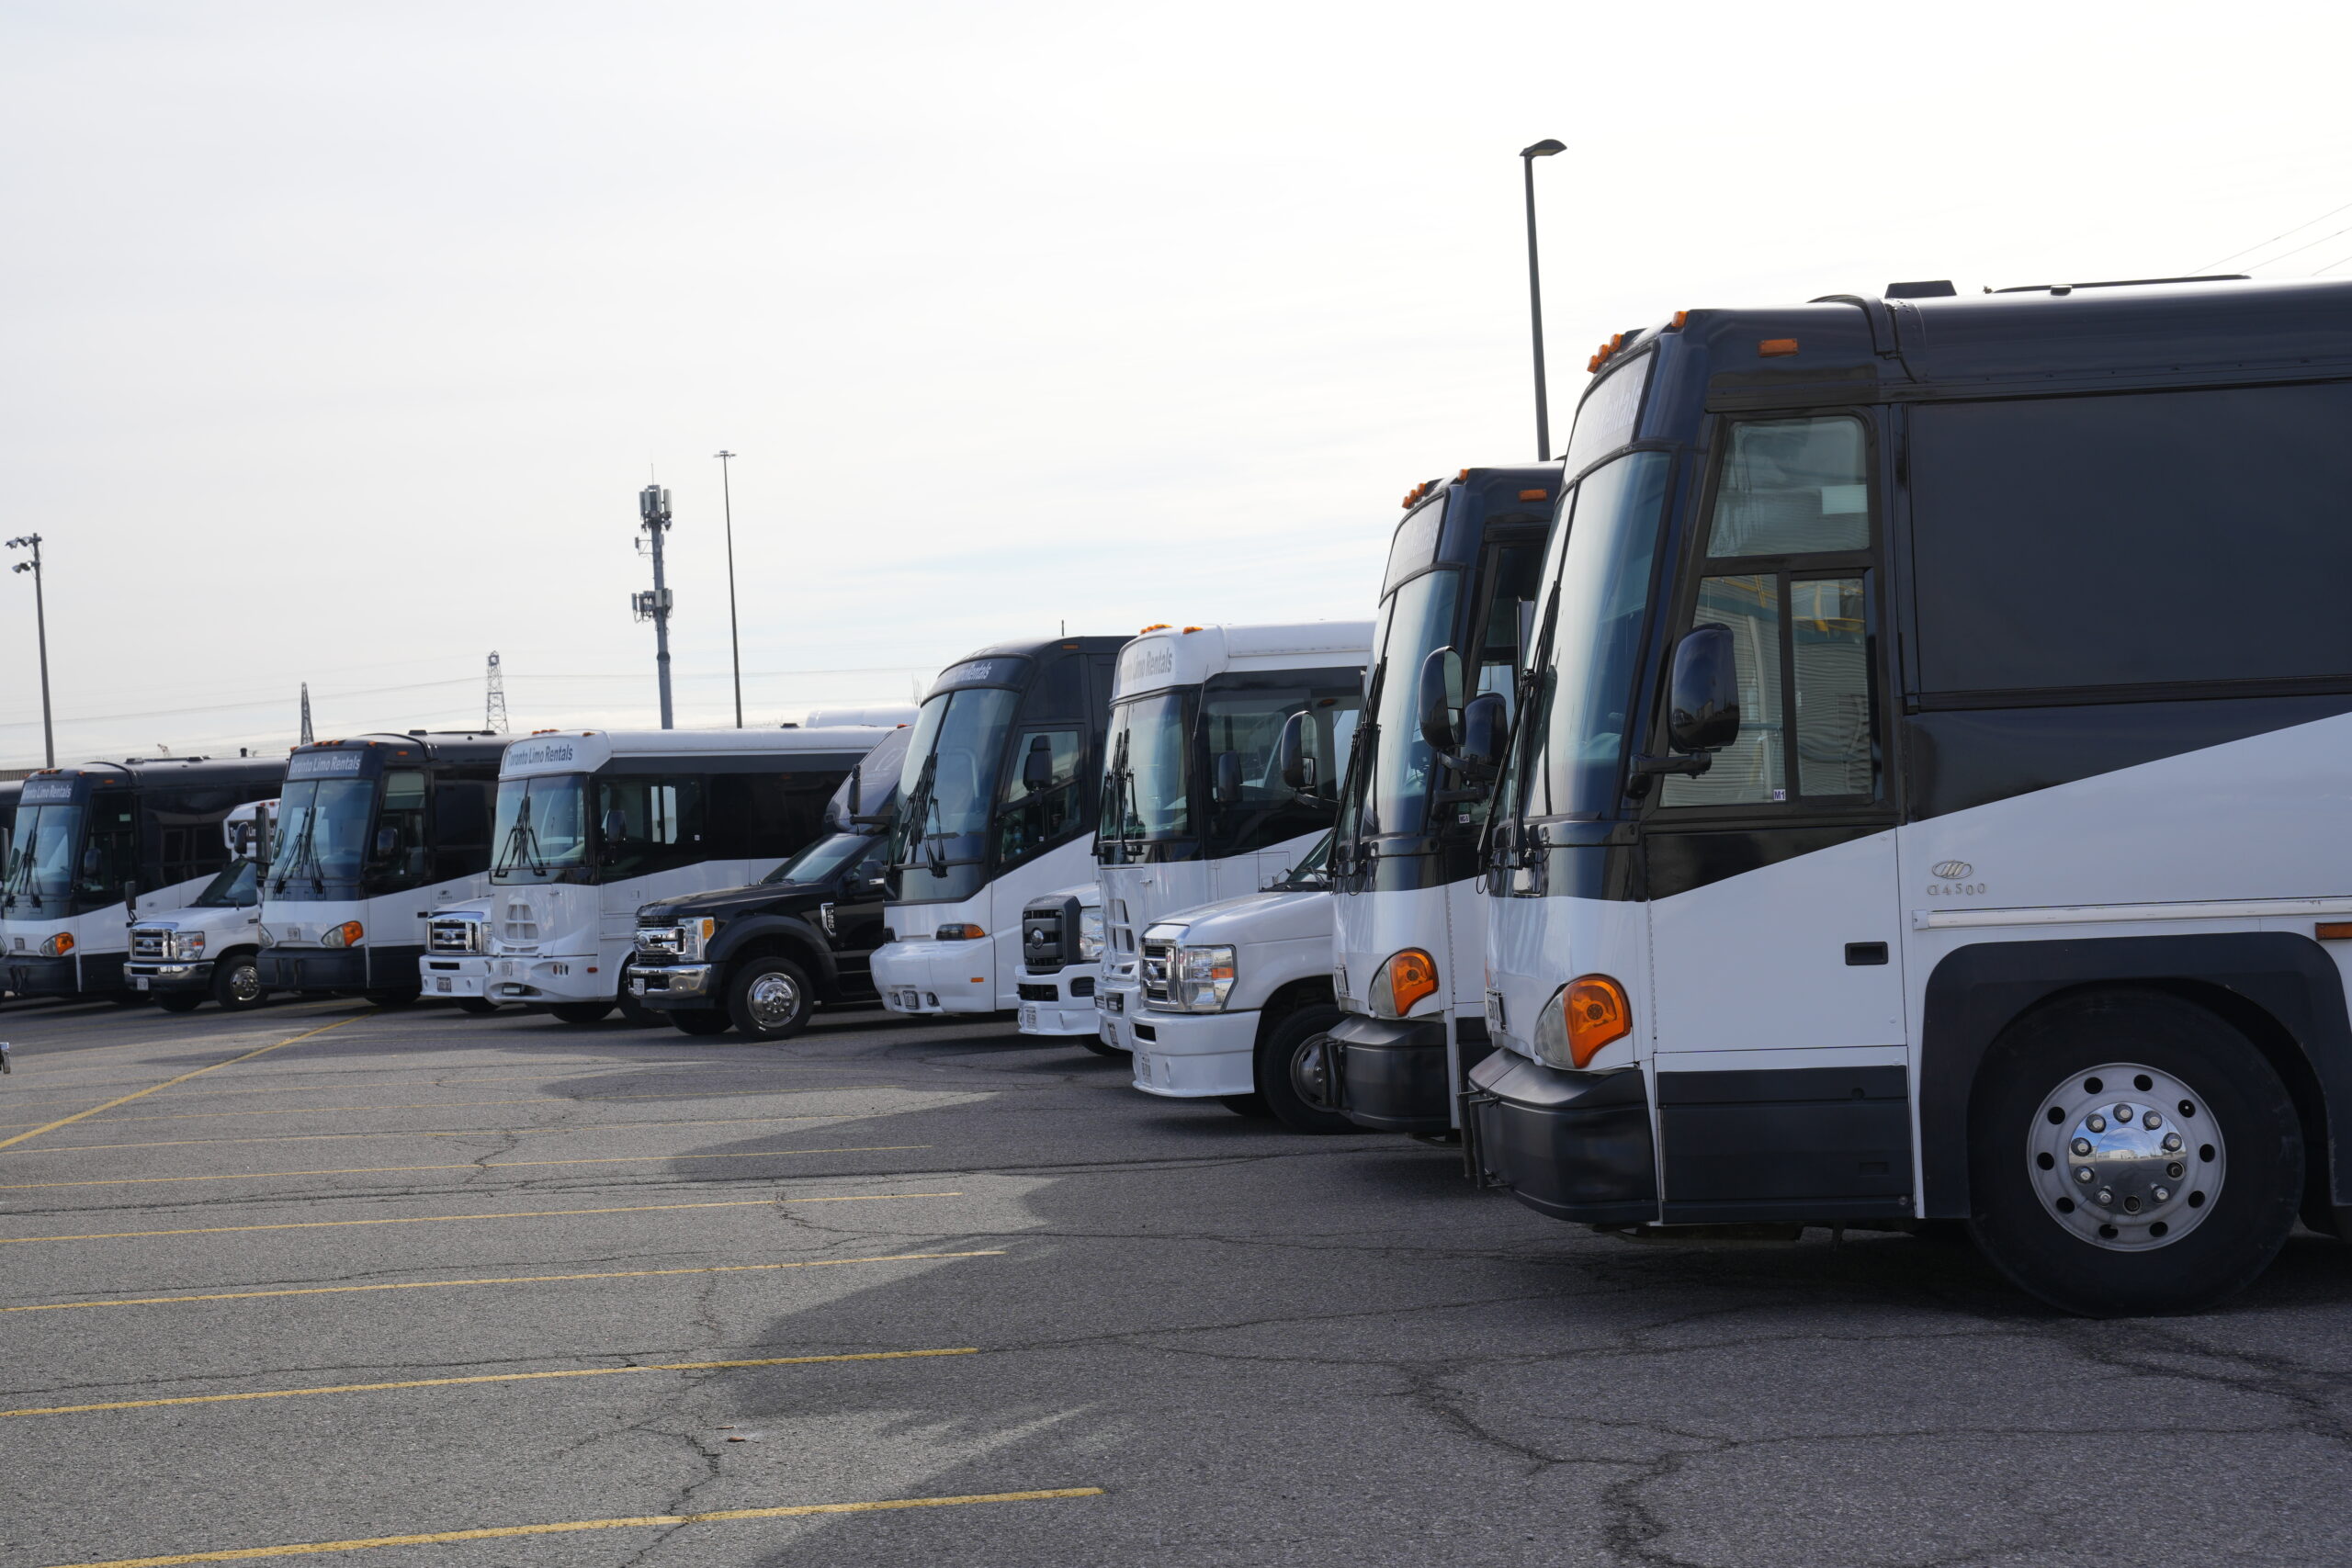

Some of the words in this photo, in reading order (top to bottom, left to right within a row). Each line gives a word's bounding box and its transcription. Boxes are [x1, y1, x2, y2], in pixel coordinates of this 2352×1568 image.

[1146, 647, 1172, 676] Rentals
[312, 757, 330, 772] Limo
[331, 755, 361, 771] Rentals
[507, 750, 528, 768] Toronto
[528, 747, 544, 764] Limo
[545, 744, 573, 763] Rentals
[50, 784, 72, 798] Rentals
[1774, 790, 1785, 799] M1
